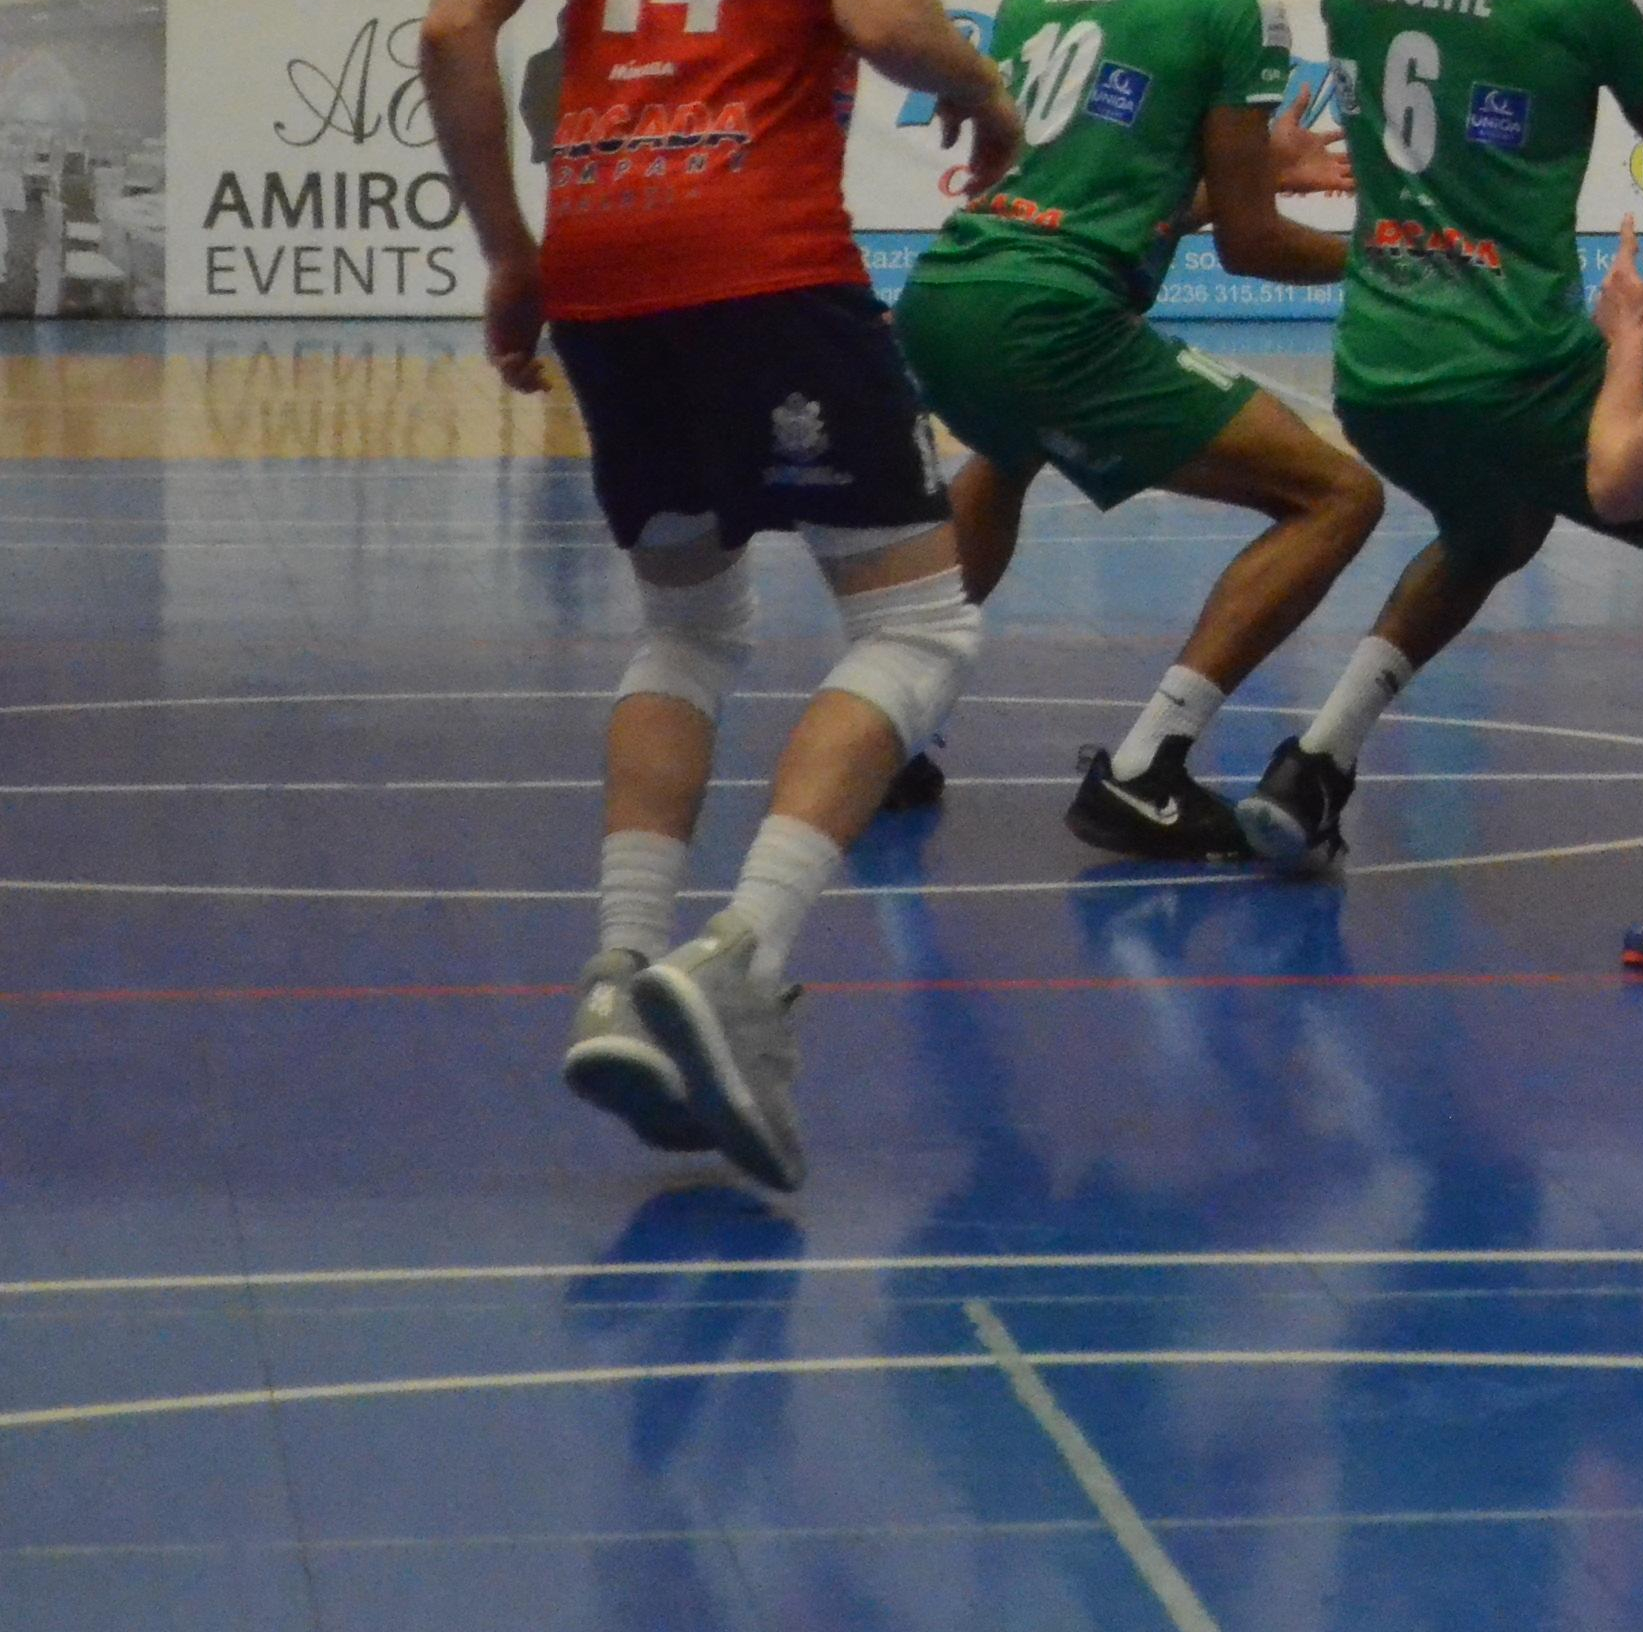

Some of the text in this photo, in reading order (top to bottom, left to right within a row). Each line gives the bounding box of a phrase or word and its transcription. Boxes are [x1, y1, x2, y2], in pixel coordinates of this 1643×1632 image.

[1016, 20, 1105, 147] 10
[1382, 30, 1441, 174] 6
[203, 170, 463, 231] AMIRO
[206, 245, 458, 297] EVENTS
[1215, 284, 1296, 304] 315.511
